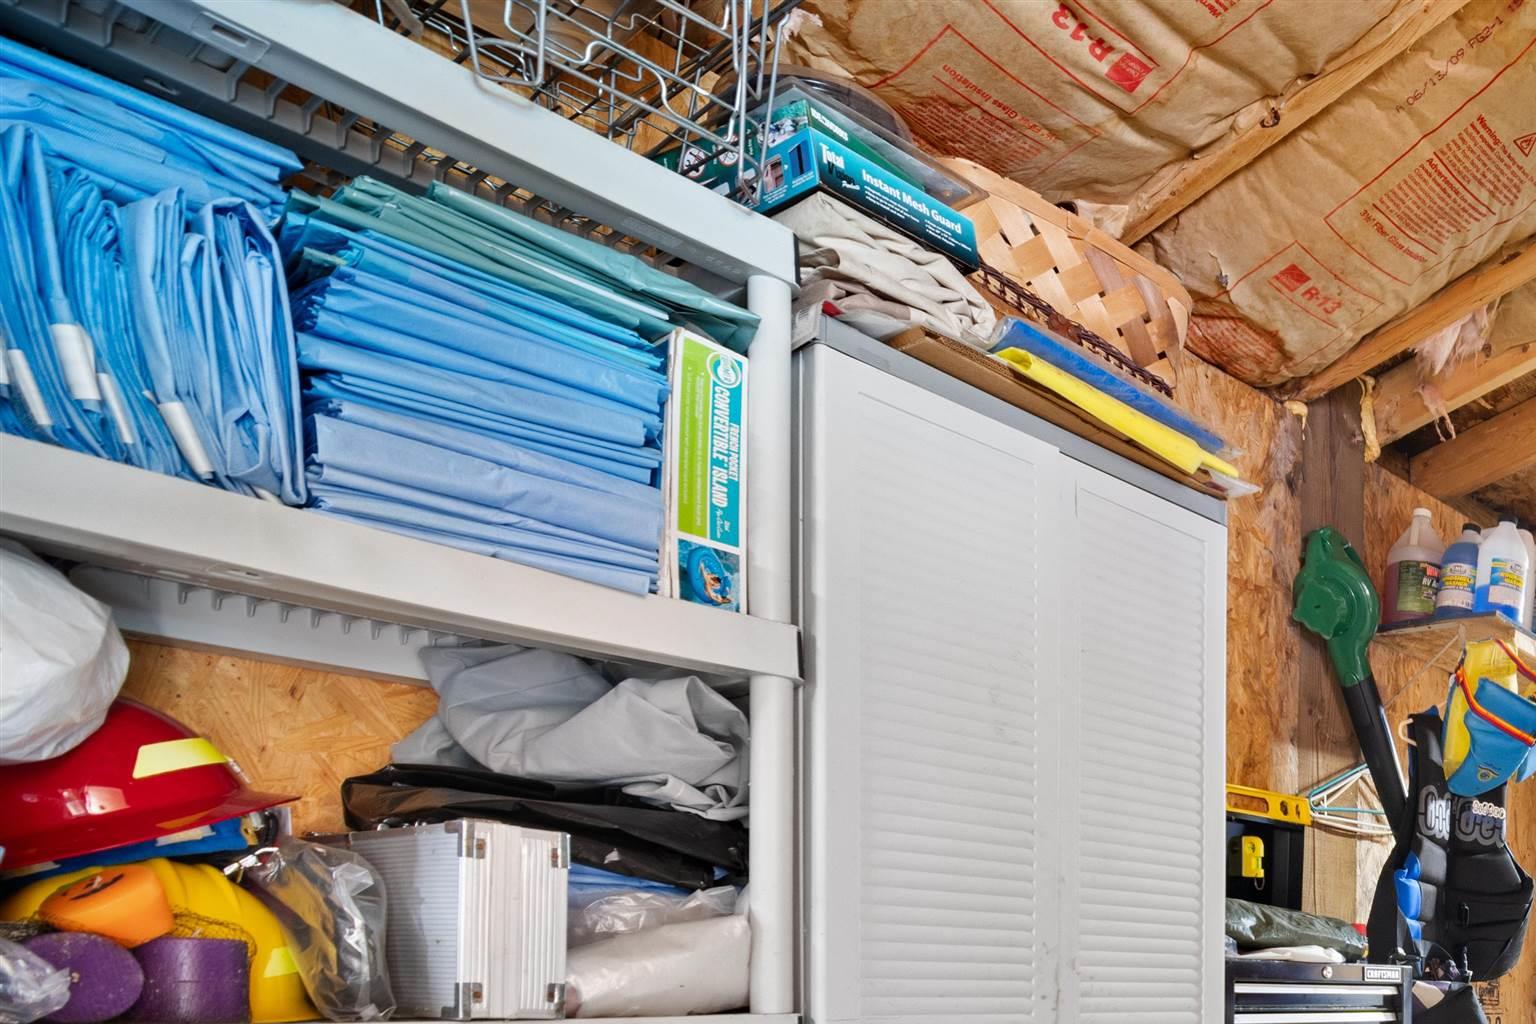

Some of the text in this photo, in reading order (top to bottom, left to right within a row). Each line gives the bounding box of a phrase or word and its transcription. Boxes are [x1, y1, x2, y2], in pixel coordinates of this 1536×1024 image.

[1052, 2, 1115, 63] R-13
[942, 63, 994, 104] Insulation
[1406, 48, 1465, 106] 06/13/09
[1476, 113, 1501, 147] Warning:
[819, 142, 845, 168] Total
[862, 169, 902, 200] Instant
[902, 193, 930, 217] Mesh
[931, 210, 962, 235] Guard
[1373, 221, 1390, 240] Fiber
[1301, 286, 1343, 315] R-13
[712, 387, 730, 463] CONVERTIBLE
[728, 423, 740, 482] FRENCH POCKET
[712, 466, 729, 509] ISLAND
[1366, 969, 1400, 980] CRAFTSMAN
